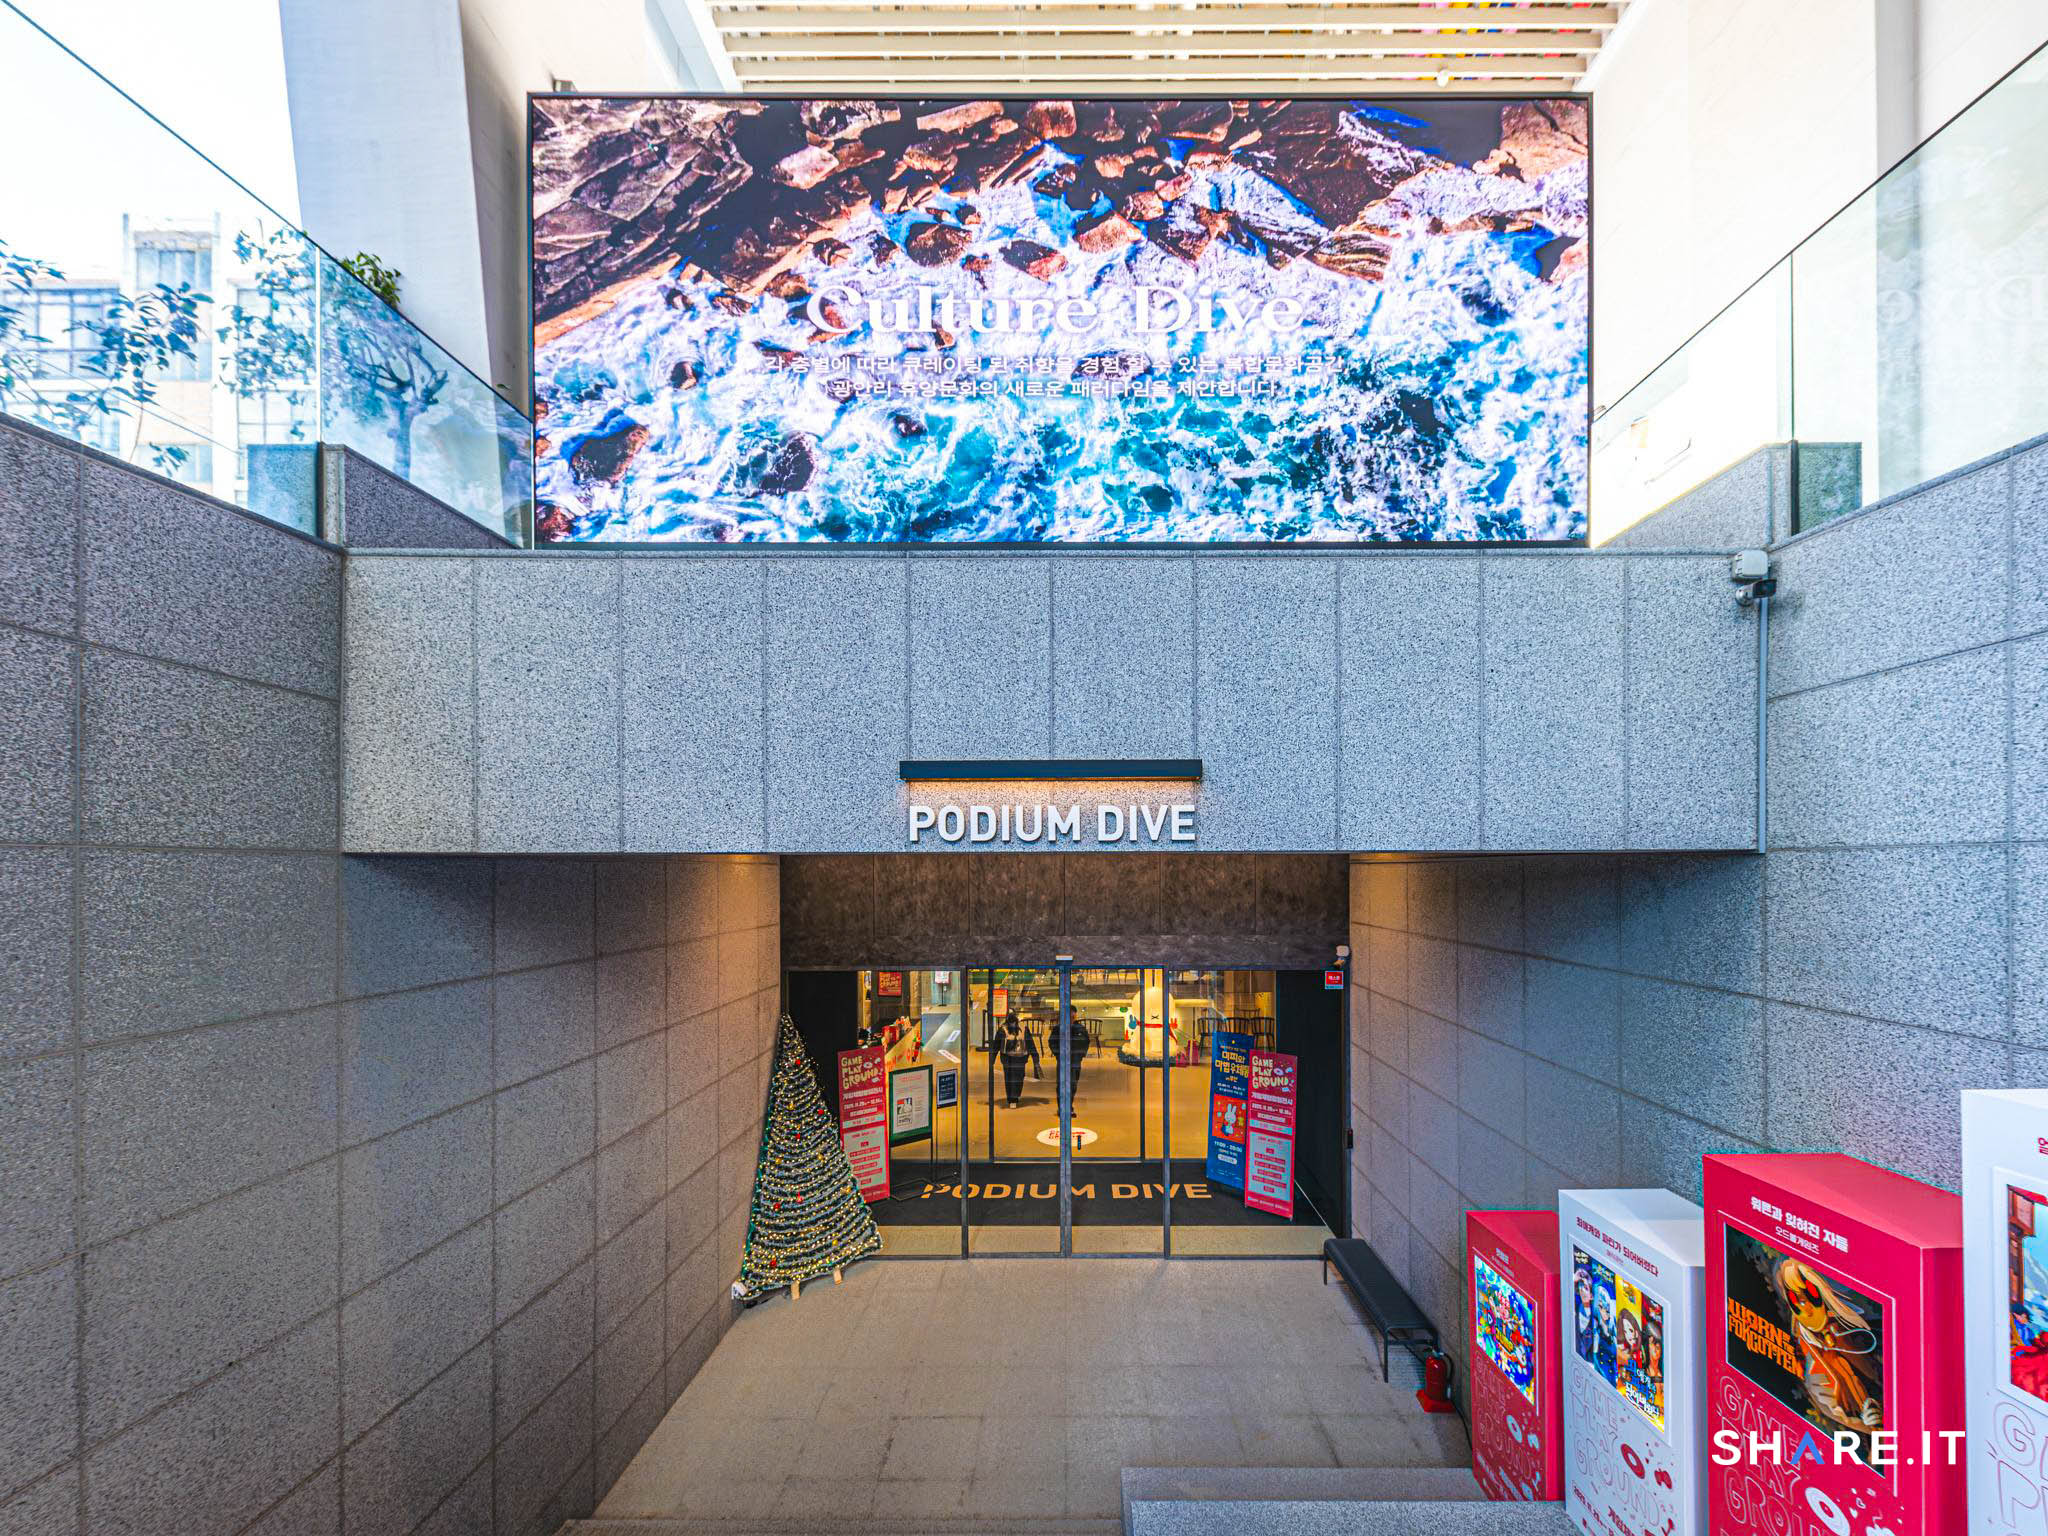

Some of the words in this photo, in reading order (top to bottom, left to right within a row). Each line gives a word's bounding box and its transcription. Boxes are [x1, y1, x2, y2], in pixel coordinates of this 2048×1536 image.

[806, 285, 1098, 334] Culture
[1133, 285, 1304, 334] Dive
[766, 357, 784, 374] 각
[792, 357, 850, 374] 층별에
[857, 357, 897, 374] 따라
[903, 357, 982, 374] 큐레이팅
[990, 357, 1008, 374] 된
[1016, 357, 1074, 374] 취향을
[1081, 357, 1120, 374] 경험
[1128, 357, 1146, 374] 할
[1152, 357, 1171, 374] 수
[1178, 357, 1219, 374] 있는
[833, 380, 892, 398] 광안리
[899, 380, 998, 398] 휴양문화의
[1005, 380, 1062, 398] 새로운
[1071, 380, 1171, 398] 패러다임을
[910, 804, 1081, 842] PODIUM
[1097, 804, 1196, 842] DIVE
[841, 1056, 863, 1068] GAME
[1252, 1055, 1274, 1068] GAME
[842, 1065, 863, 1079] PLAY
[1252, 1066, 1273, 1077] PLAY
[1252, 1076, 1289, 1089] GROUND
[920, 1183, 1096, 1200] PODIUM
[1111, 1183, 1213, 1200] DIVE
